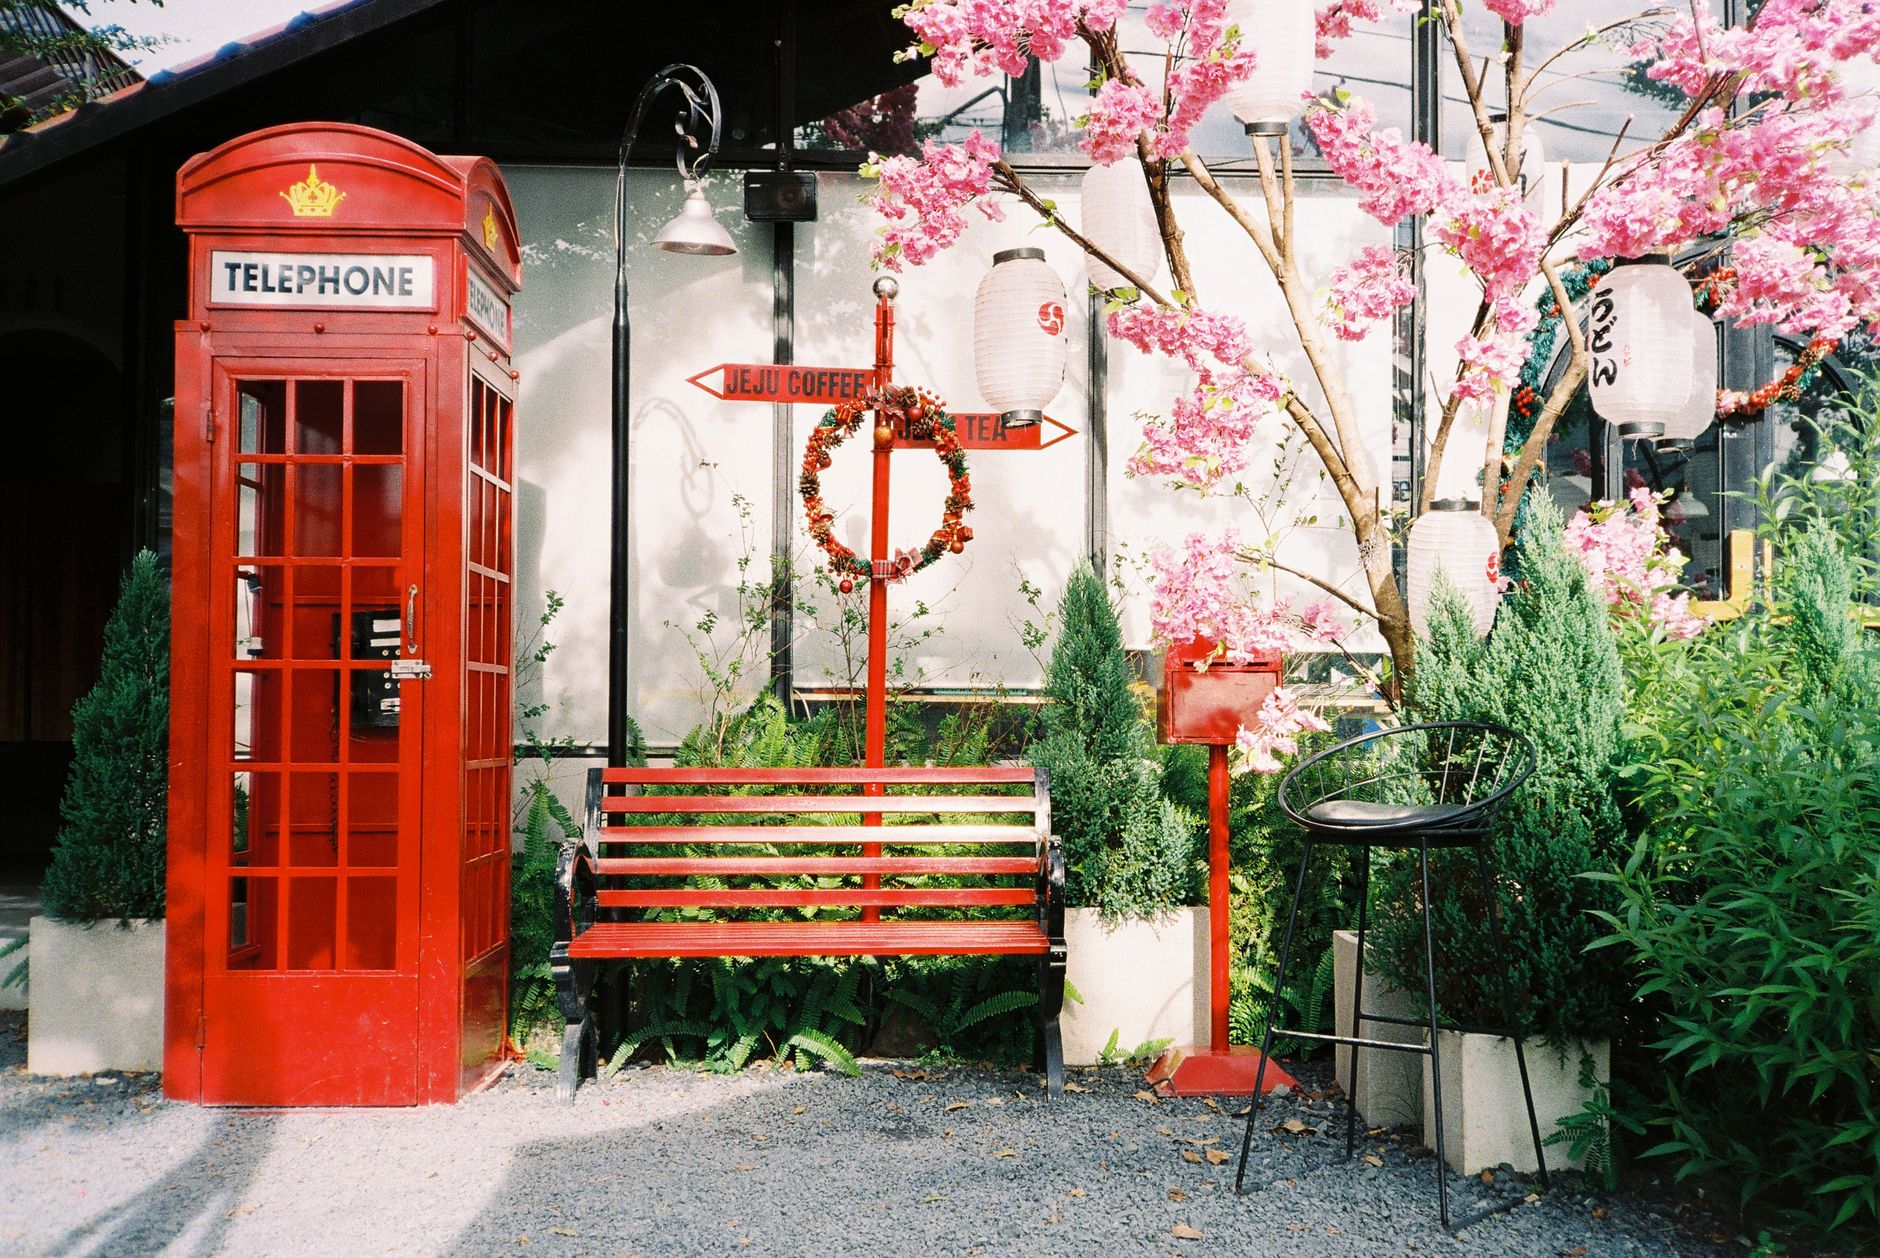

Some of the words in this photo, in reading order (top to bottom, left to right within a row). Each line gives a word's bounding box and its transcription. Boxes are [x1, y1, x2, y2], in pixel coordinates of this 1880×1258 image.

[224, 262, 413, 296] TELEPHONE
[1591, 287, 1618, 388] うどん
[726, 368, 780, 395] JEJU
[787, 370, 866, 399] COFFEE
[964, 415, 1008, 442] TEA
